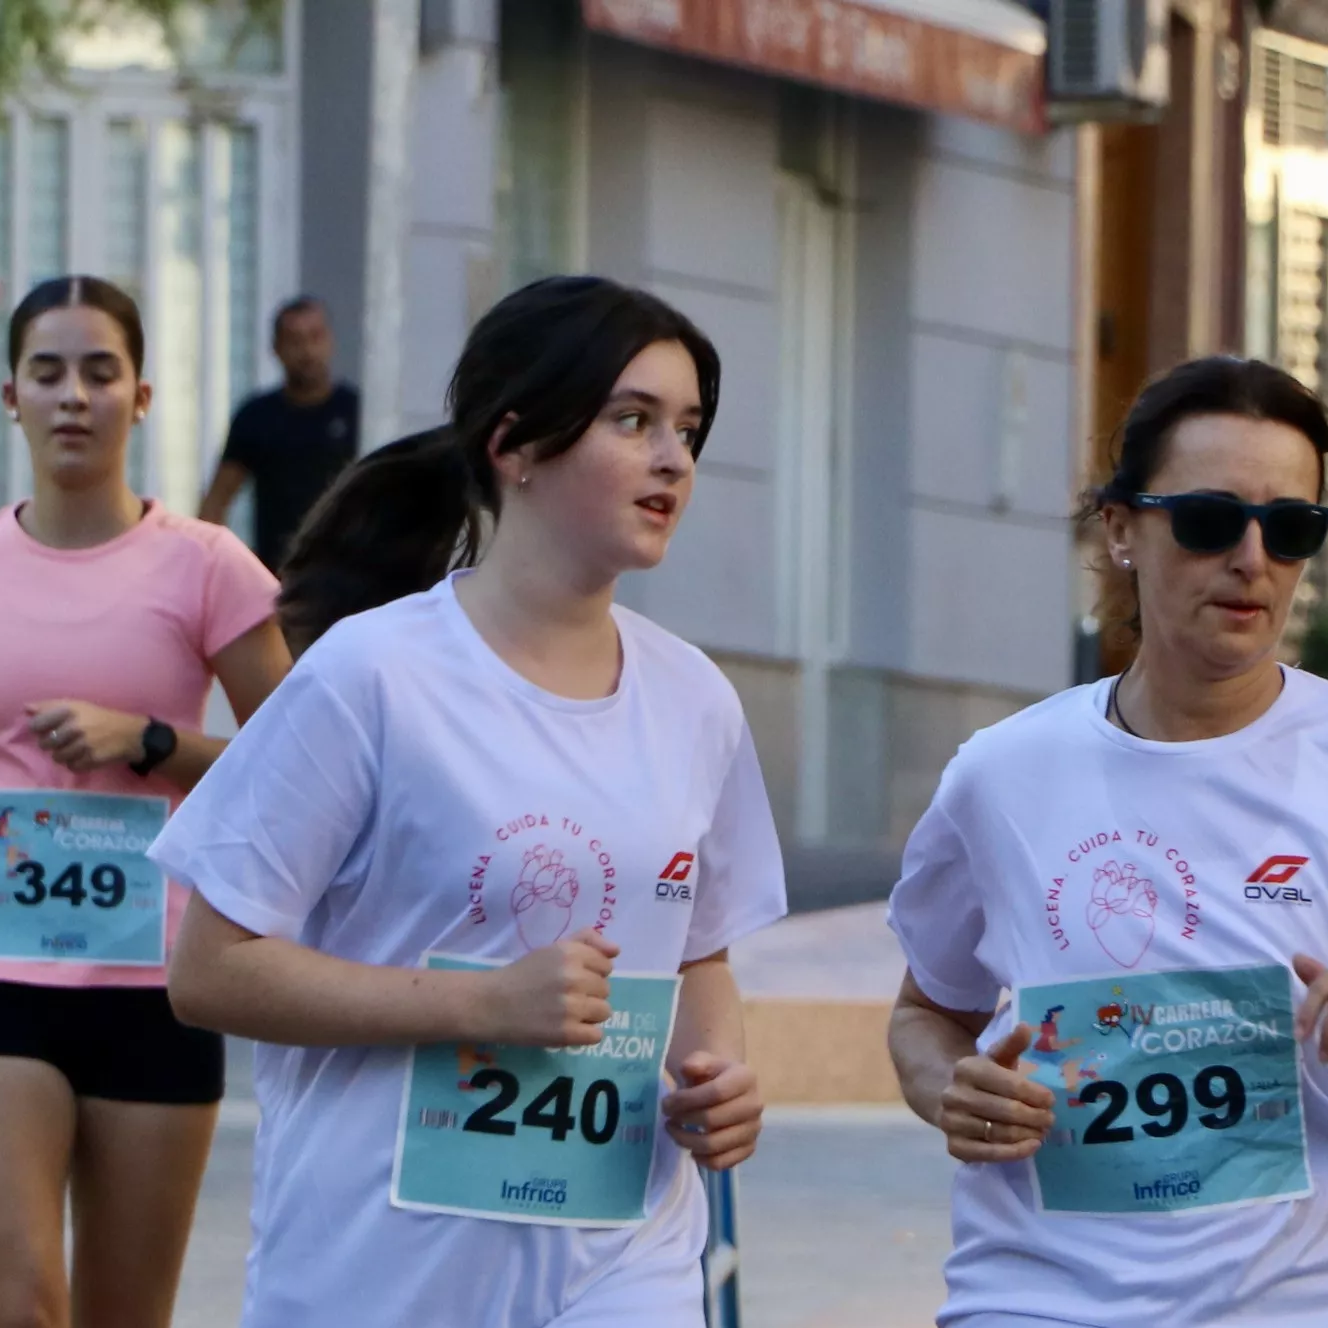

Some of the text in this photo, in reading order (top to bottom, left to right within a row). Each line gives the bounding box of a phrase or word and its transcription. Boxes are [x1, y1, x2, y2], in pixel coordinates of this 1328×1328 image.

[496, 814, 549, 841] CUIDA
[562, 817, 582, 836] TU
[1068, 830, 1122, 862] CUIDA
[1137, 830, 1158, 847] TU
[14, 860, 126, 909] 349
[1153, 1000, 1235, 1025] CARRERA
[463, 1068, 620, 1144] 240
[1079, 1064, 1246, 1145] 299
[500, 1179, 567, 1204] Infrico
[1133, 1179, 1201, 1200] Infrico
